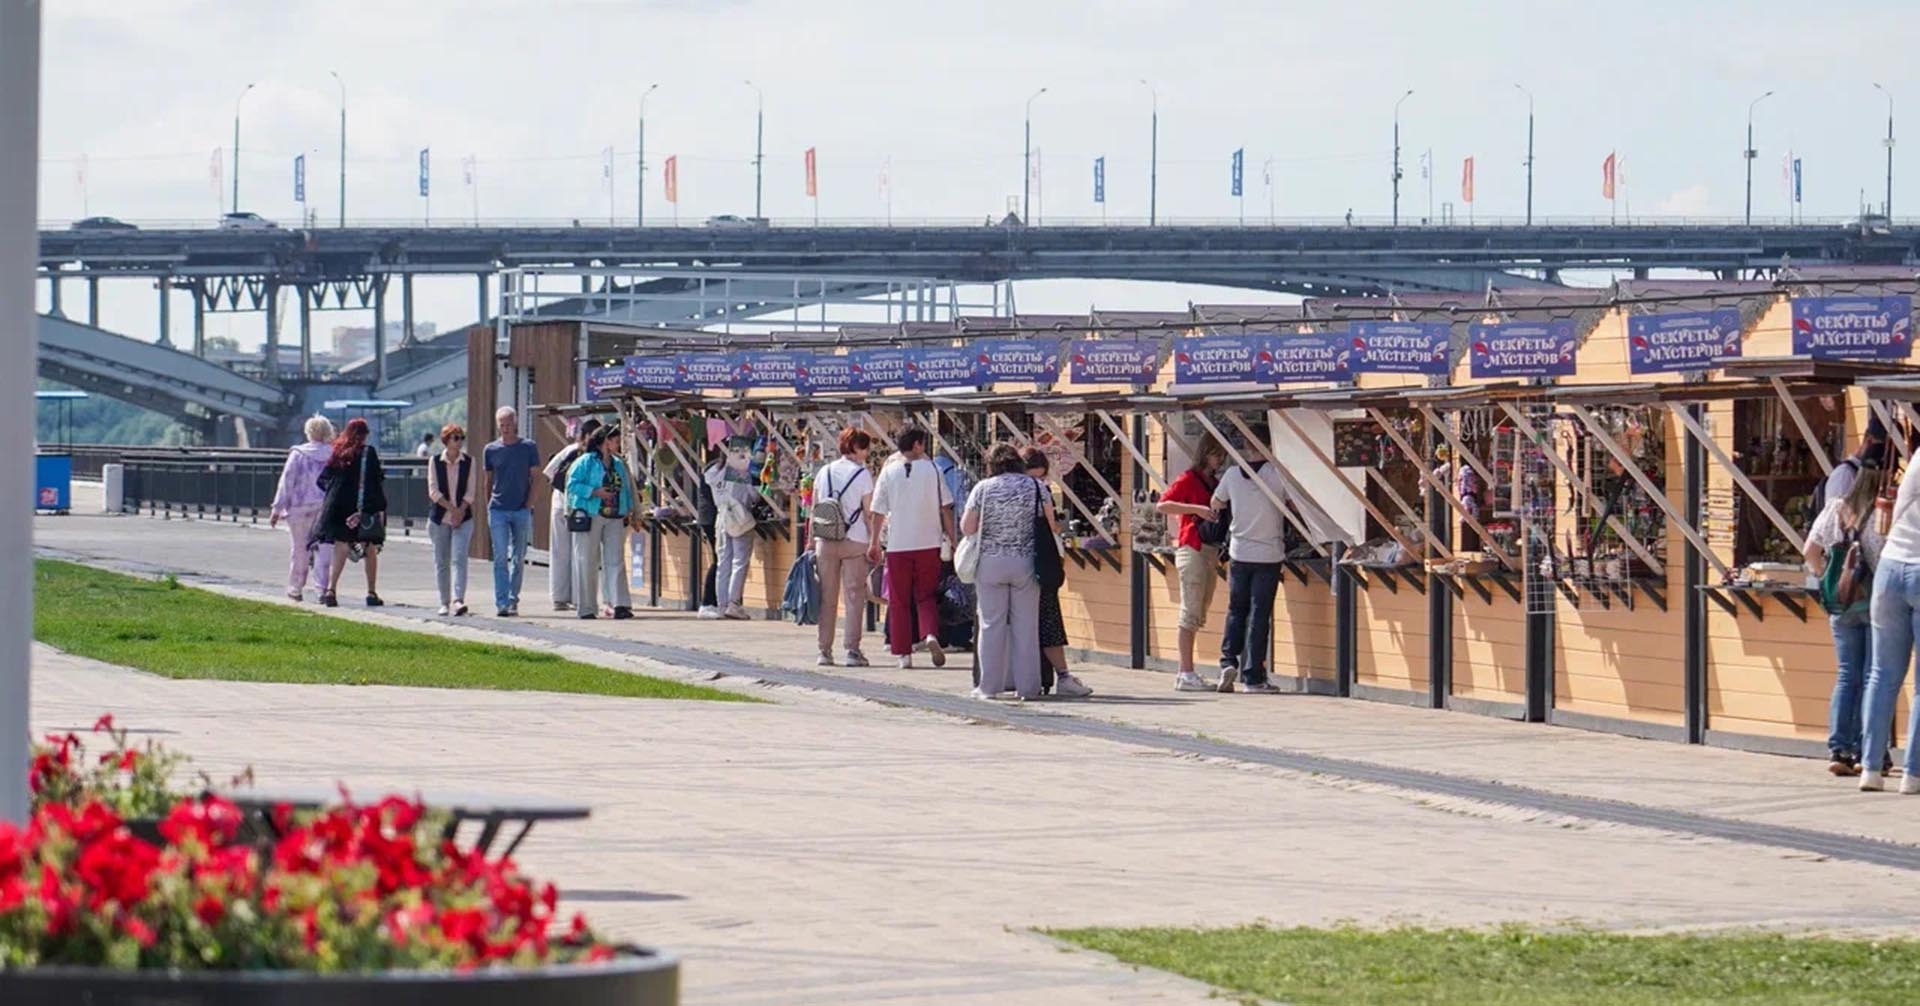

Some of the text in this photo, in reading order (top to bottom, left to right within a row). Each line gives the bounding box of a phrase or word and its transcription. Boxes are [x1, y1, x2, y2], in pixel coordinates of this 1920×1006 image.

[1815, 312, 1890, 329] СЕКРЕТЫ
[1368, 335, 1432, 348] СЕКРЕТЫ
[1651, 325, 1721, 345] СЕКРЕТЫ
[1491, 336, 1558, 351] СЕКРЕТЫ
[992, 351, 1044, 362] СЕКРЕТЫ
[1088, 351, 1142, 363] СЕКРЕТЫ
[1193, 347, 1250, 361] СЕКРЕТЫ
[1275, 345, 1335, 360] СЕКРЕТЫ
[919, 357, 970, 370] СЕКРЕТЫ
